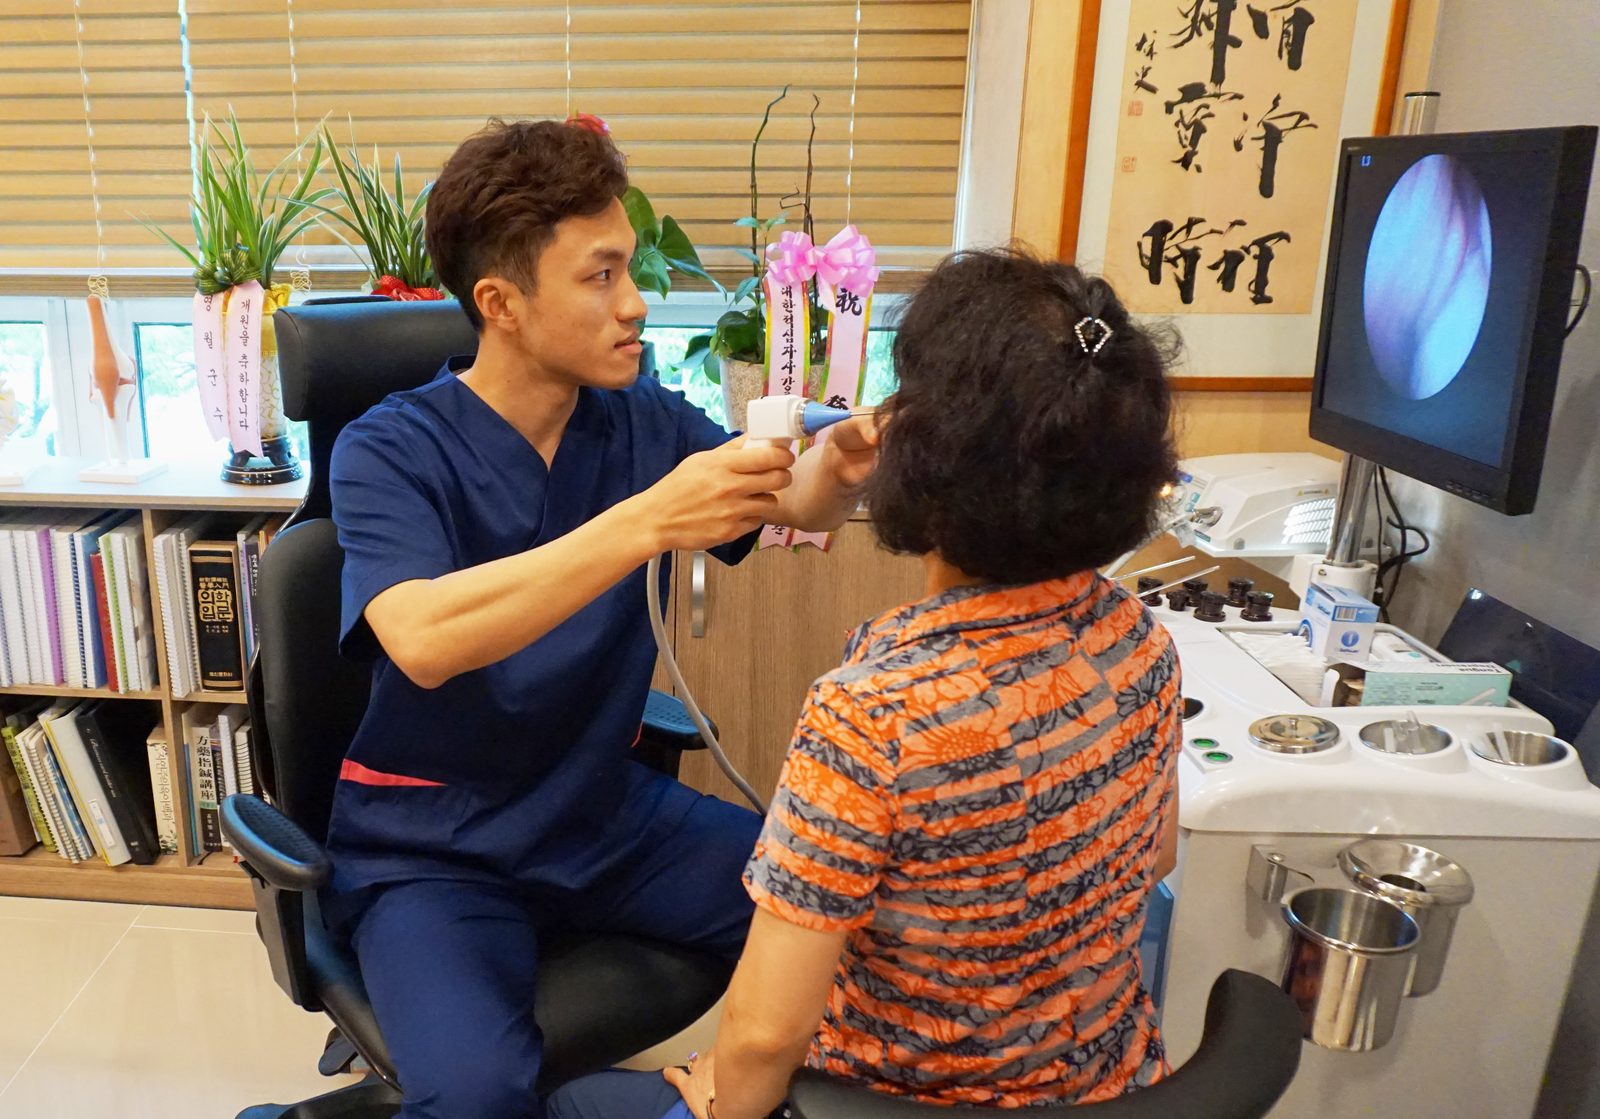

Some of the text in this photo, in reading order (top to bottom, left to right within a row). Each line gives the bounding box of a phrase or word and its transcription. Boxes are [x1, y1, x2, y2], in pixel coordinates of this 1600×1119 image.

[835, 287, 863, 316] 祝
[238, 299, 251, 431] 개원을 축하합니다
